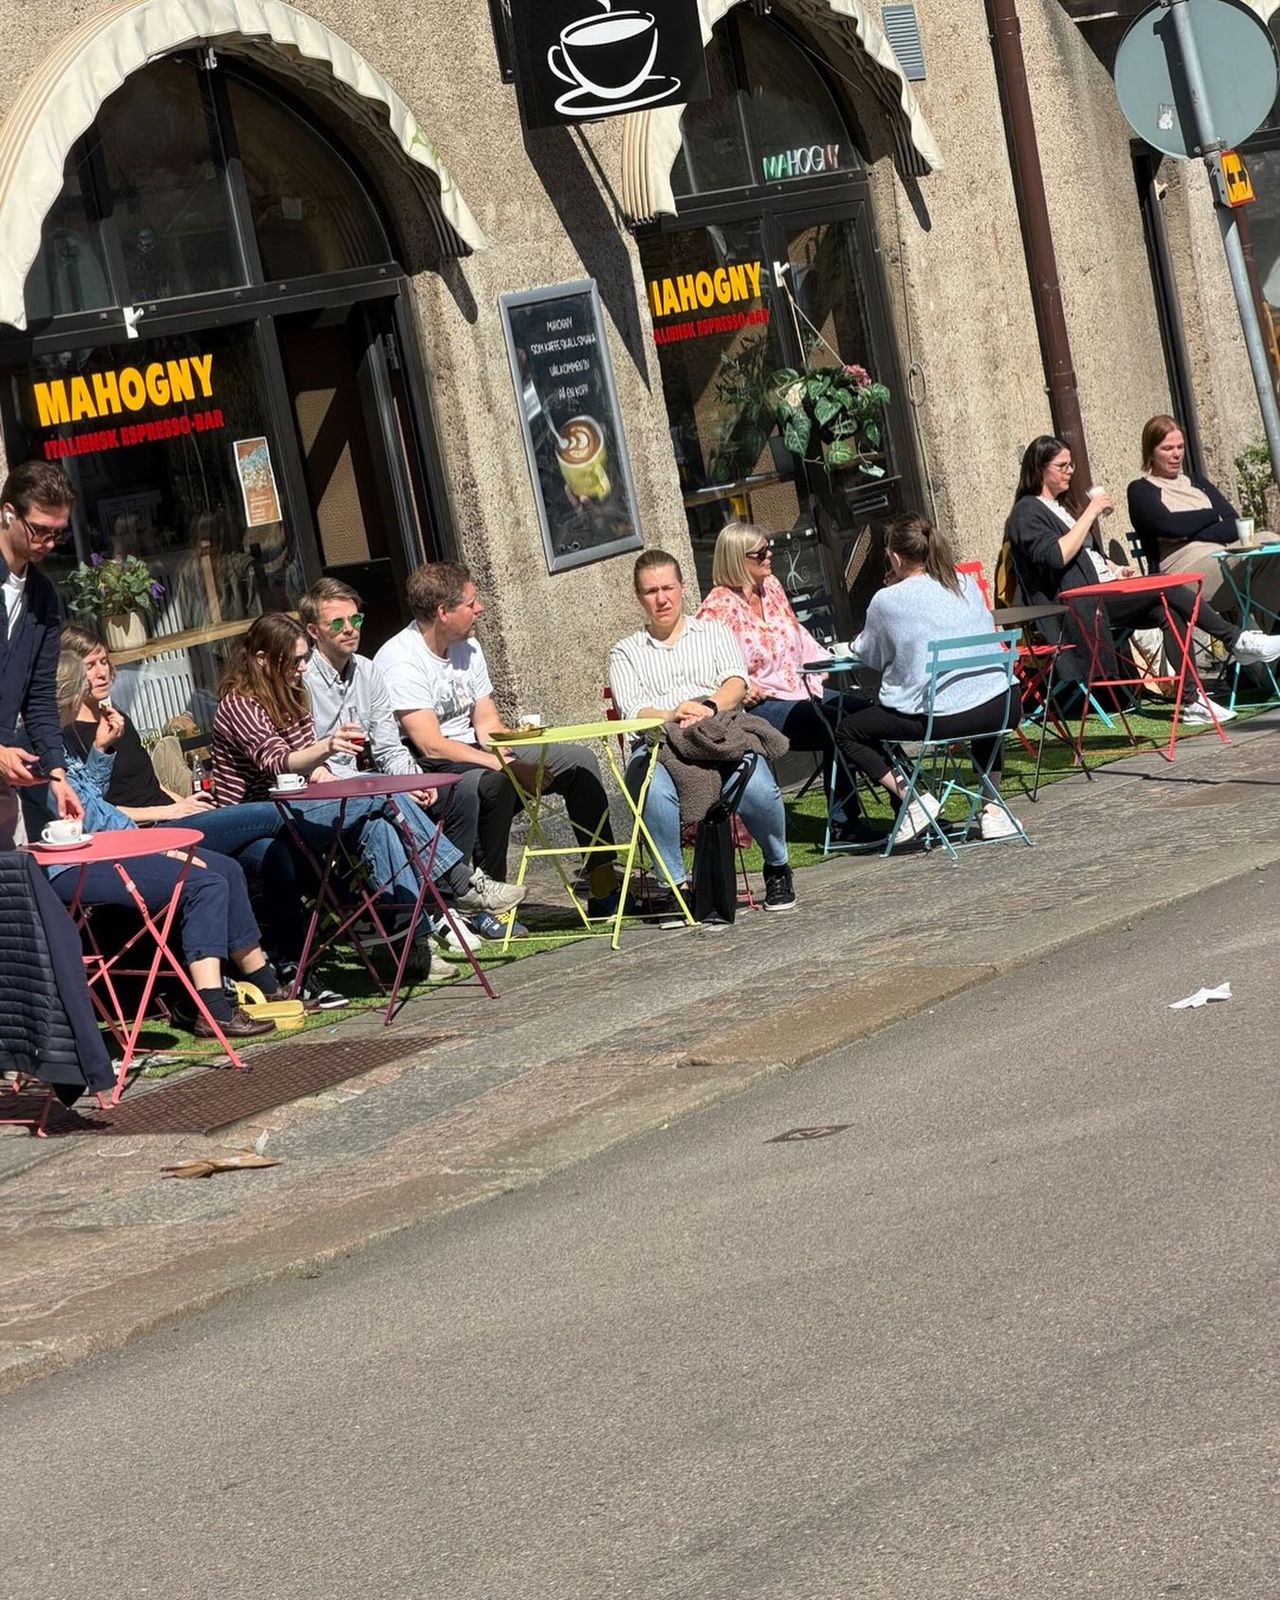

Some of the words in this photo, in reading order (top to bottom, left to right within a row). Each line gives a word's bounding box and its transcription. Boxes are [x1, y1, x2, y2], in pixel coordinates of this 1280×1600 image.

[763, 144, 839, 180] MAHOGNY
[652, 321, 697, 346] ALIENSK
[34, 354, 213, 427] MAHOGNY
[44, 428, 119, 460] ITALIENSK
[120, 409, 225, 446] ESPRESSO-BAR
